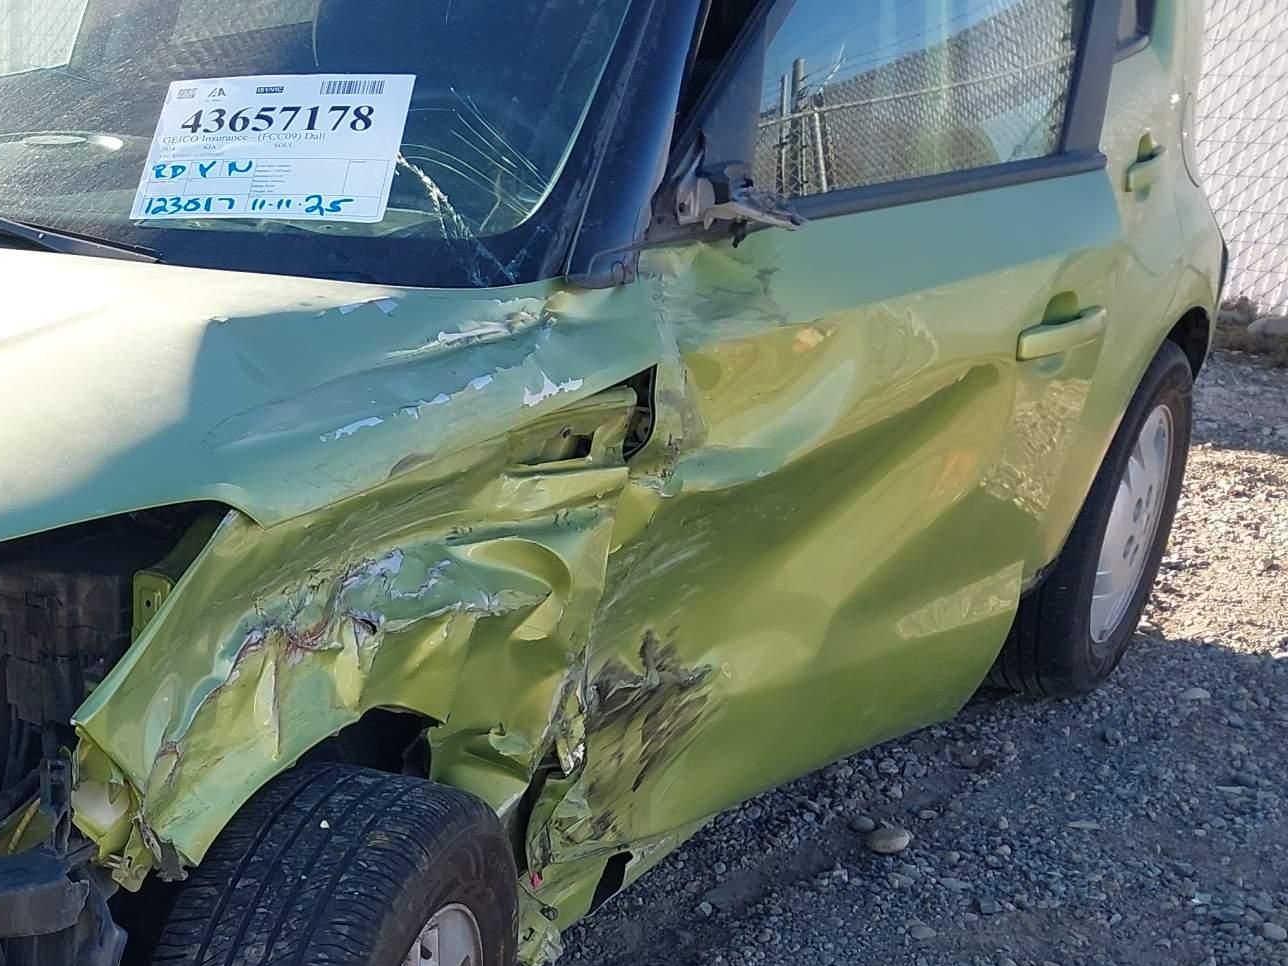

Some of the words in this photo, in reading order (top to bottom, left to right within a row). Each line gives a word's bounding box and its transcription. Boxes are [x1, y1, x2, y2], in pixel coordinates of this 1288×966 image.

[181, 105, 374, 133] 43657178
[163, 135, 199, 144] GEICO
[202, 134, 248, 142] Insurance
[257, 132, 302, 142] (FCC09)
[304, 132, 326, 140] Dall
